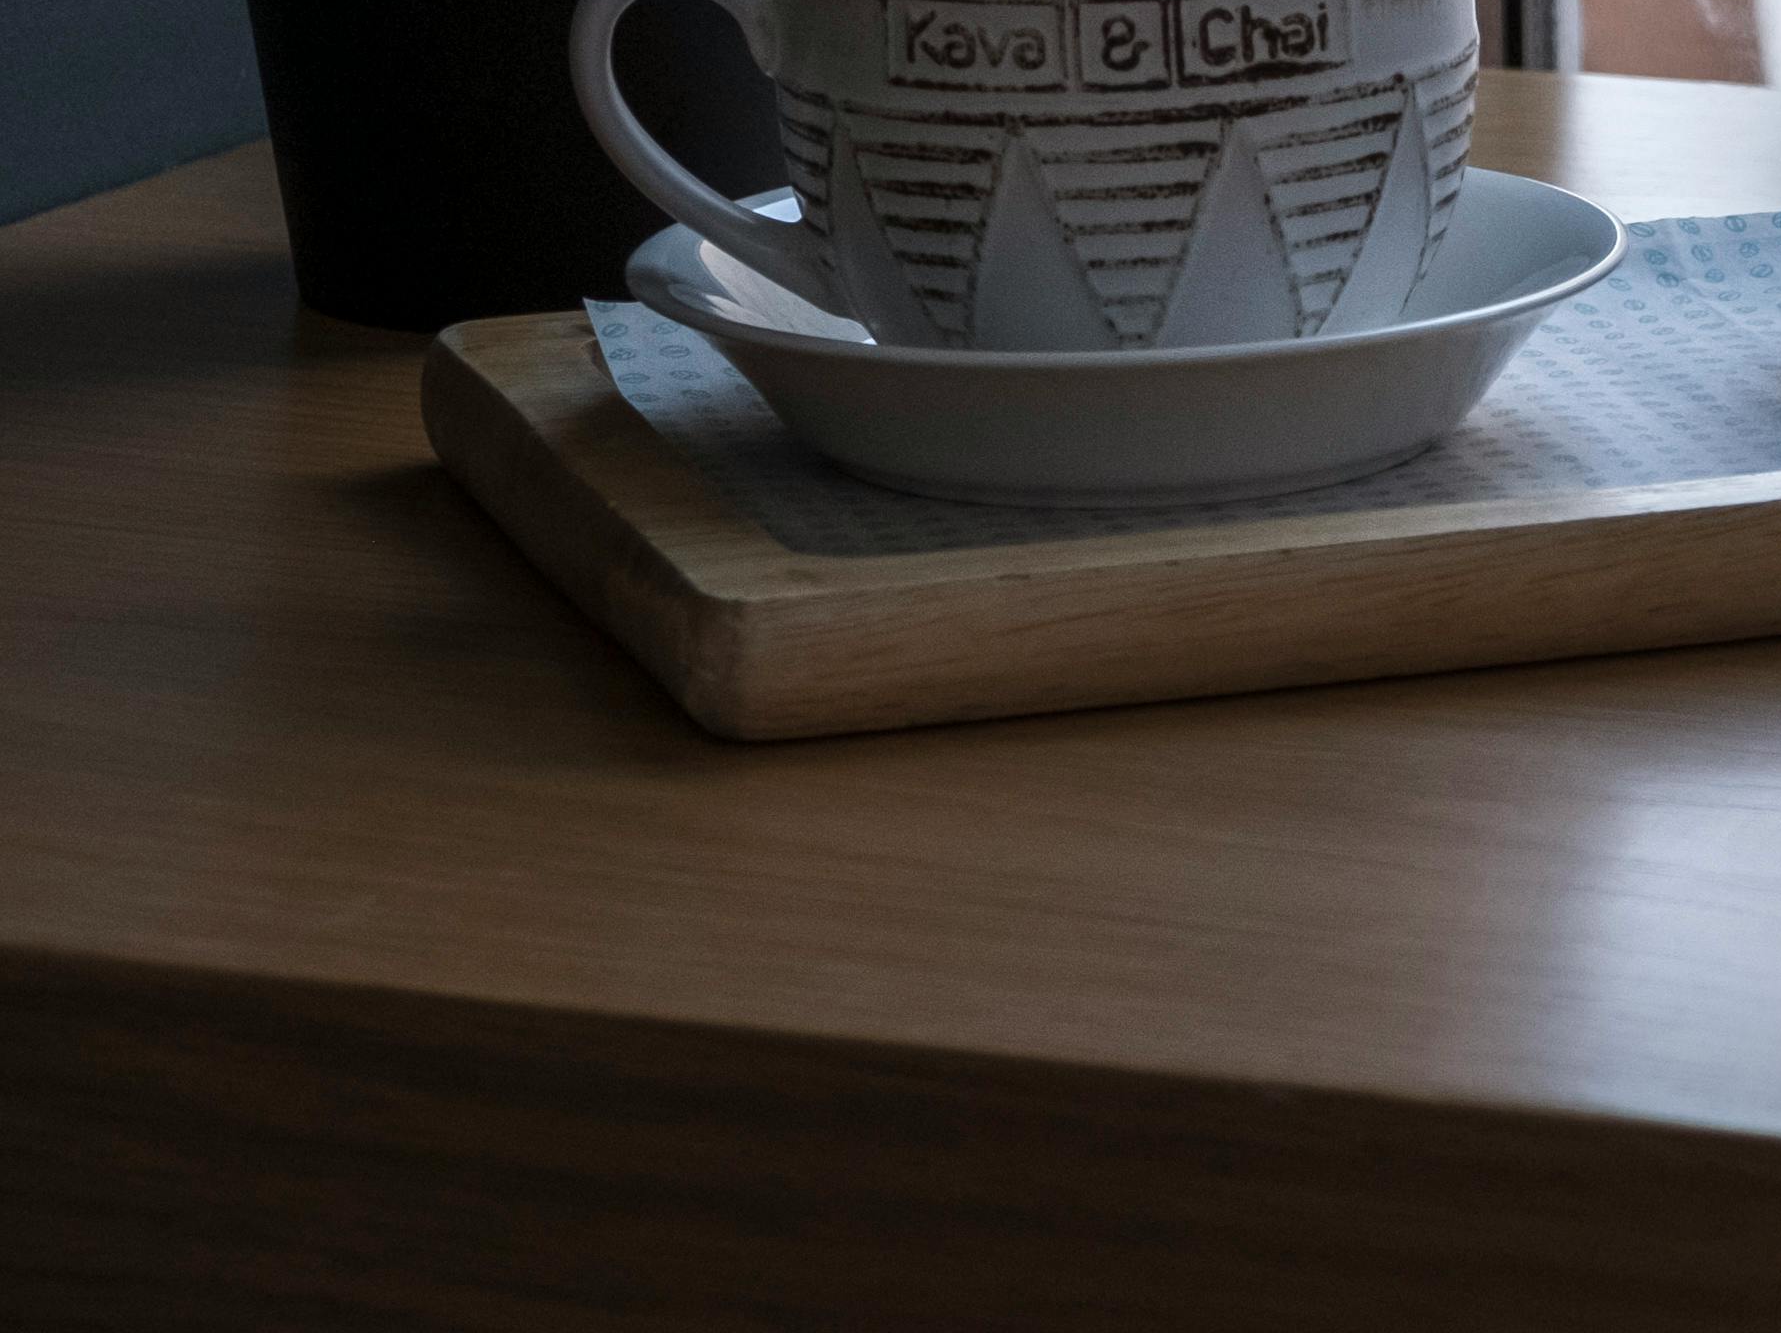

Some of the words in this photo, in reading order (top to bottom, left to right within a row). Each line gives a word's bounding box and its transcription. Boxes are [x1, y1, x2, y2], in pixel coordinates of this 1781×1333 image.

[904, 9, 1046, 70] Kava
[1100, 14, 1150, 71] &
[1197, 3, 1329, 66] Chai
